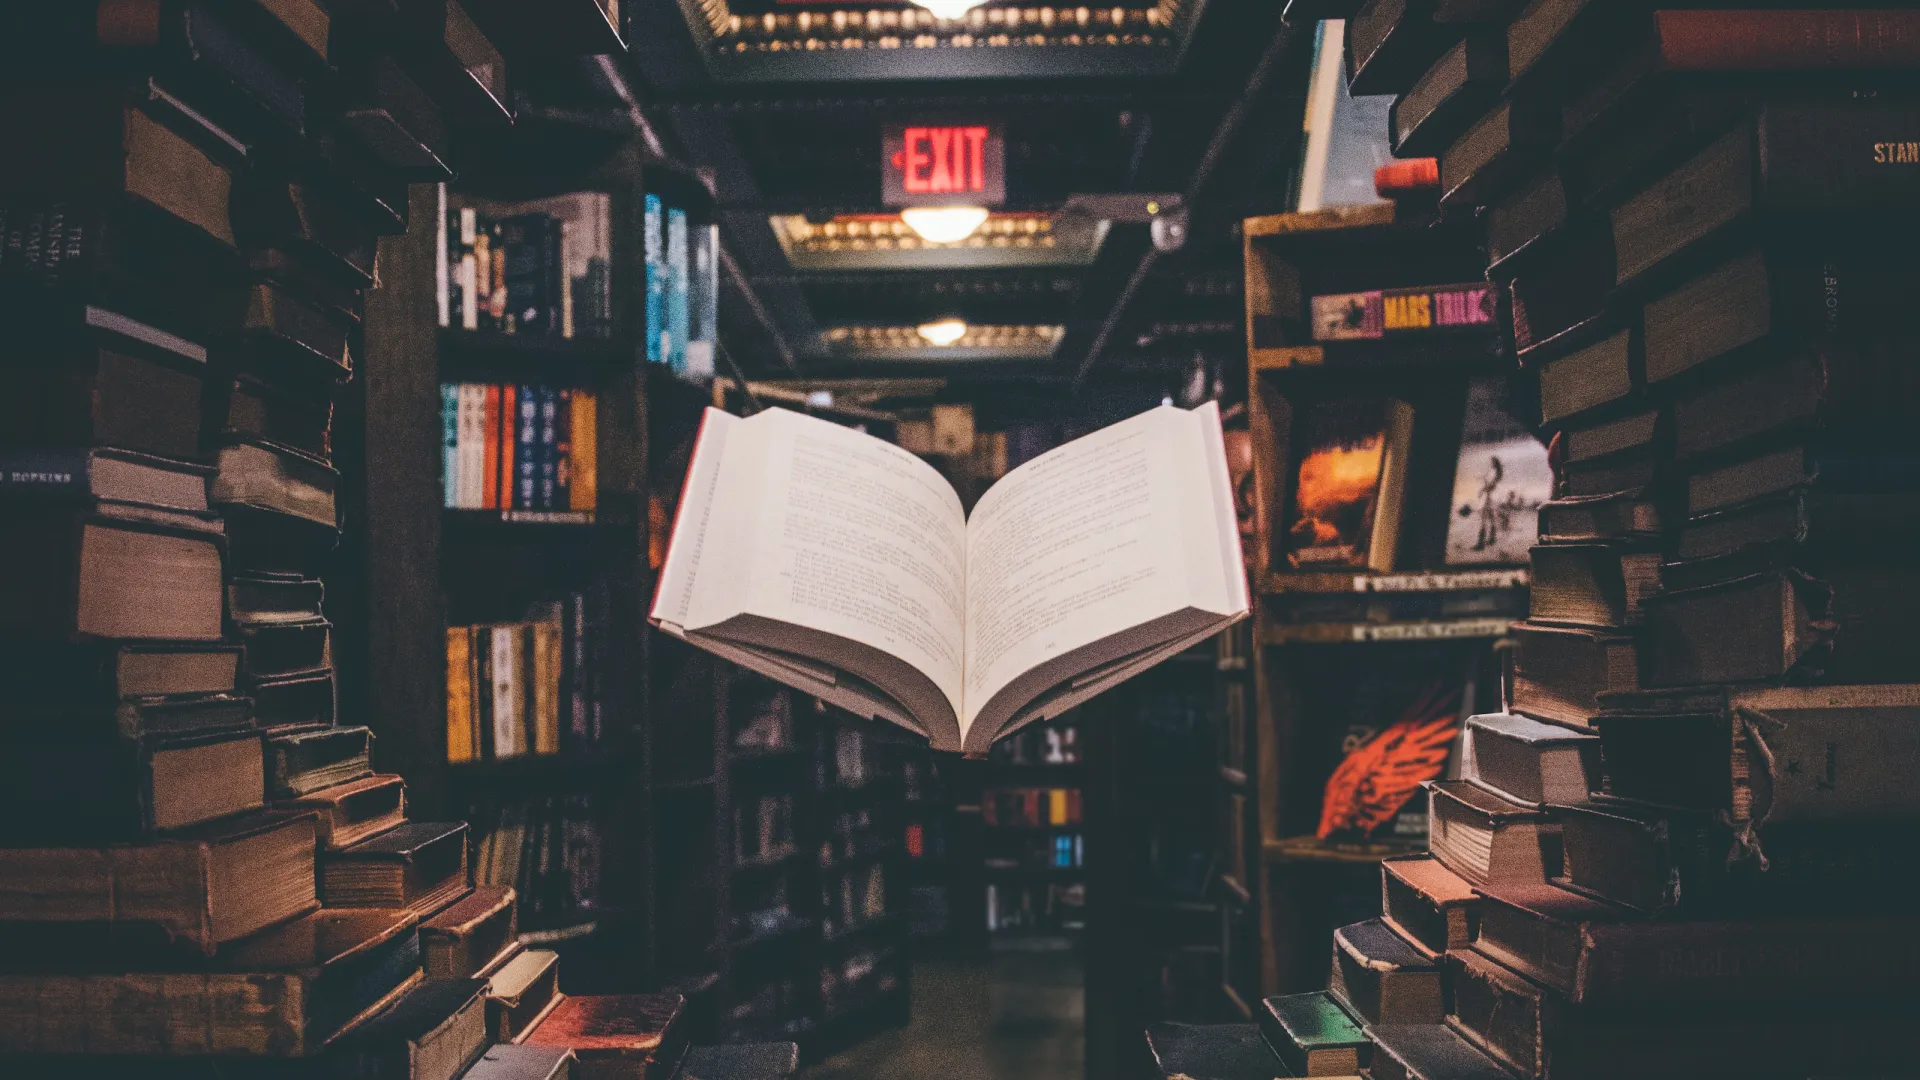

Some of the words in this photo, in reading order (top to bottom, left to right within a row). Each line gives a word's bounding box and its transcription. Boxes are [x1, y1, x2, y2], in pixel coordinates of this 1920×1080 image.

[904, 127, 988, 191] EXIT
[1872, 141, 1920, 164] STAN
[1383, 294, 1431, 328] MARS
[11, 472, 72, 483] HOPKINS
